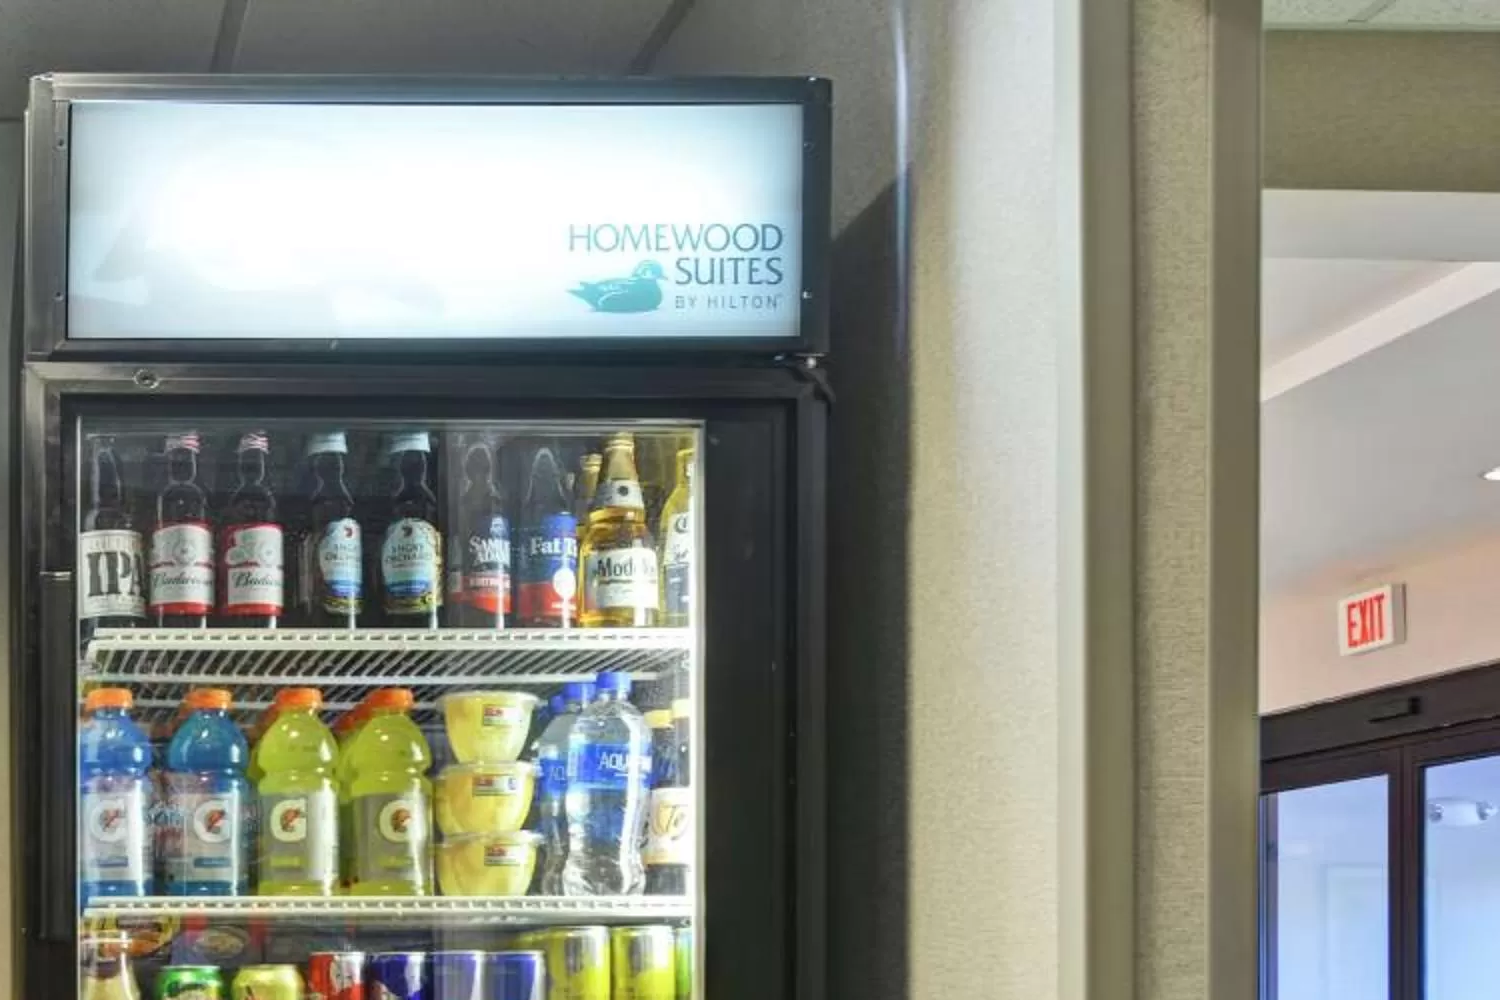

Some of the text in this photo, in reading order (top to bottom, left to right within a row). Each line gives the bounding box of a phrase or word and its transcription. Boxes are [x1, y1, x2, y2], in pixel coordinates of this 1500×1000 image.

[569, 223, 784, 253] HOMEWOOD
[674, 256, 784, 286] SUITES
[675, 295, 778, 309] BY HILTON
[531, 537, 561, 555] Fat
[87, 551, 142, 597] IPA
[1347, 593, 1385, 648] EXIT
[271, 800, 307, 841] G
